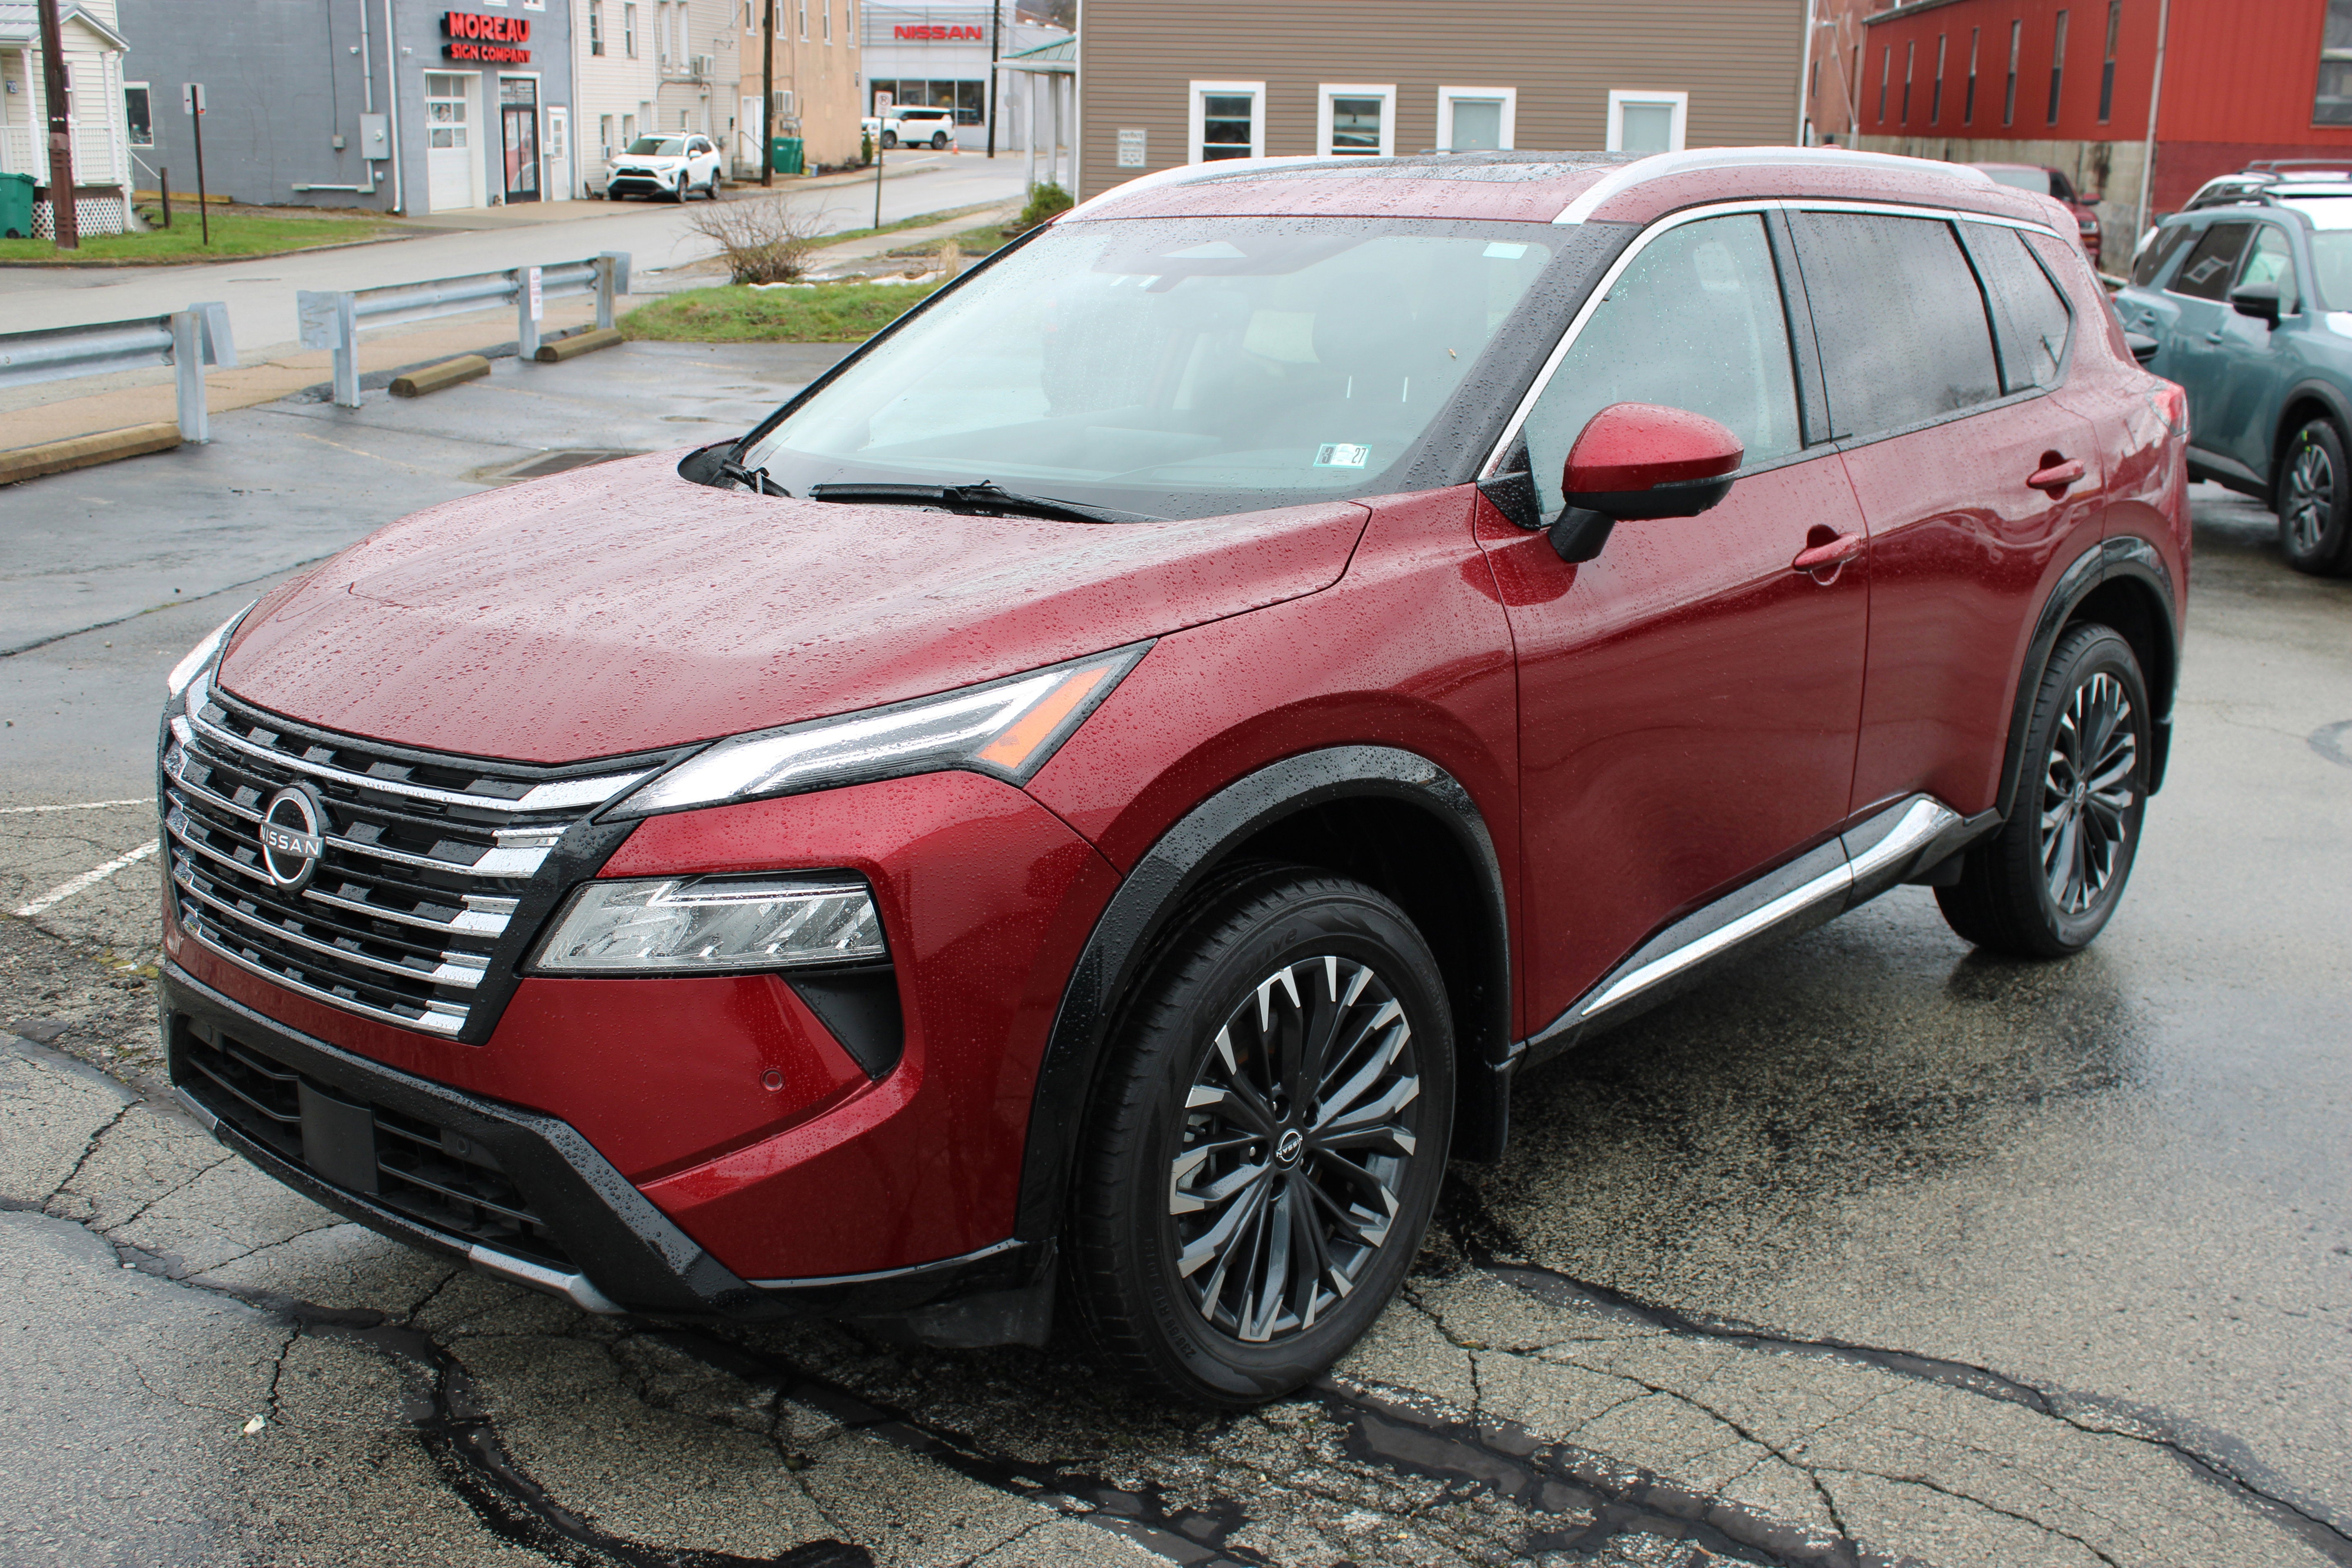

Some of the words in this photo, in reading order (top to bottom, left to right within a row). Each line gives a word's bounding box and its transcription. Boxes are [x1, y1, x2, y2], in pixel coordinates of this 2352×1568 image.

[449, 11, 530, 42] MOREAU
[894, 25, 983, 39] NISSAN
[451, 43, 479, 60] SIGN
[481, 45, 530, 63] COMPANY
[1321, 447, 1334, 464] 3
[1351, 448, 1367, 465] 27
[260, 825, 319, 855] NISSAN
[1276, 1134, 1303, 1157] NISSAN
